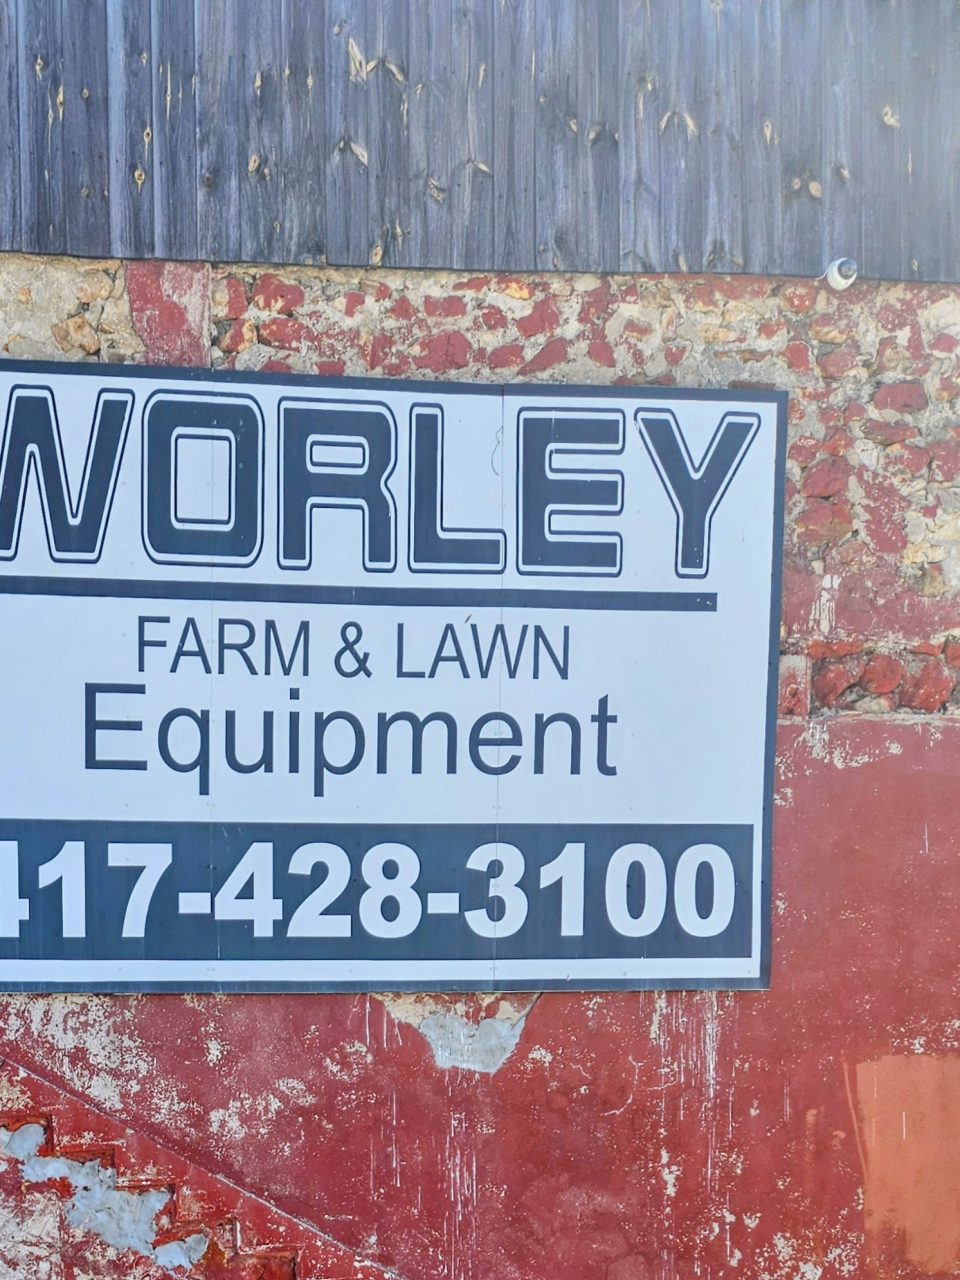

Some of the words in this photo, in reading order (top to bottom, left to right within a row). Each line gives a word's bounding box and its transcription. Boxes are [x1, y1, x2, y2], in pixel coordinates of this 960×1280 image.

[137, 615, 310, 677] FARM
[334, 620, 373, 678] &
[397, 622, 570, 681] LAWN
[84, 682, 619, 798] Equipment
